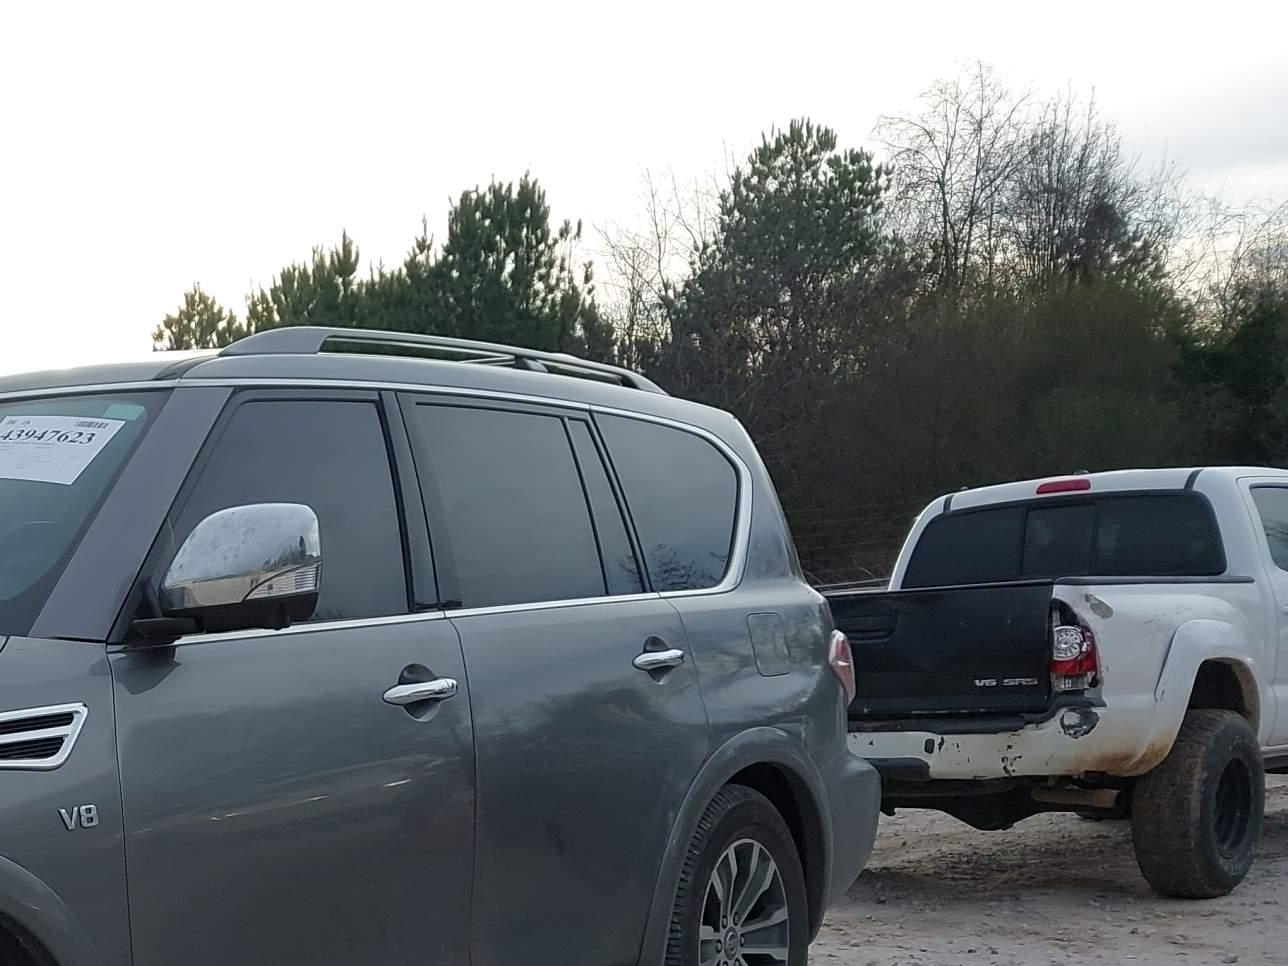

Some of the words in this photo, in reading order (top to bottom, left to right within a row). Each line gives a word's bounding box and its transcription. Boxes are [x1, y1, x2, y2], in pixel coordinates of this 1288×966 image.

[0, 428, 96, 445] 43947623
[974, 679, 997, 687] V6
[57, 804, 99, 831] V8
